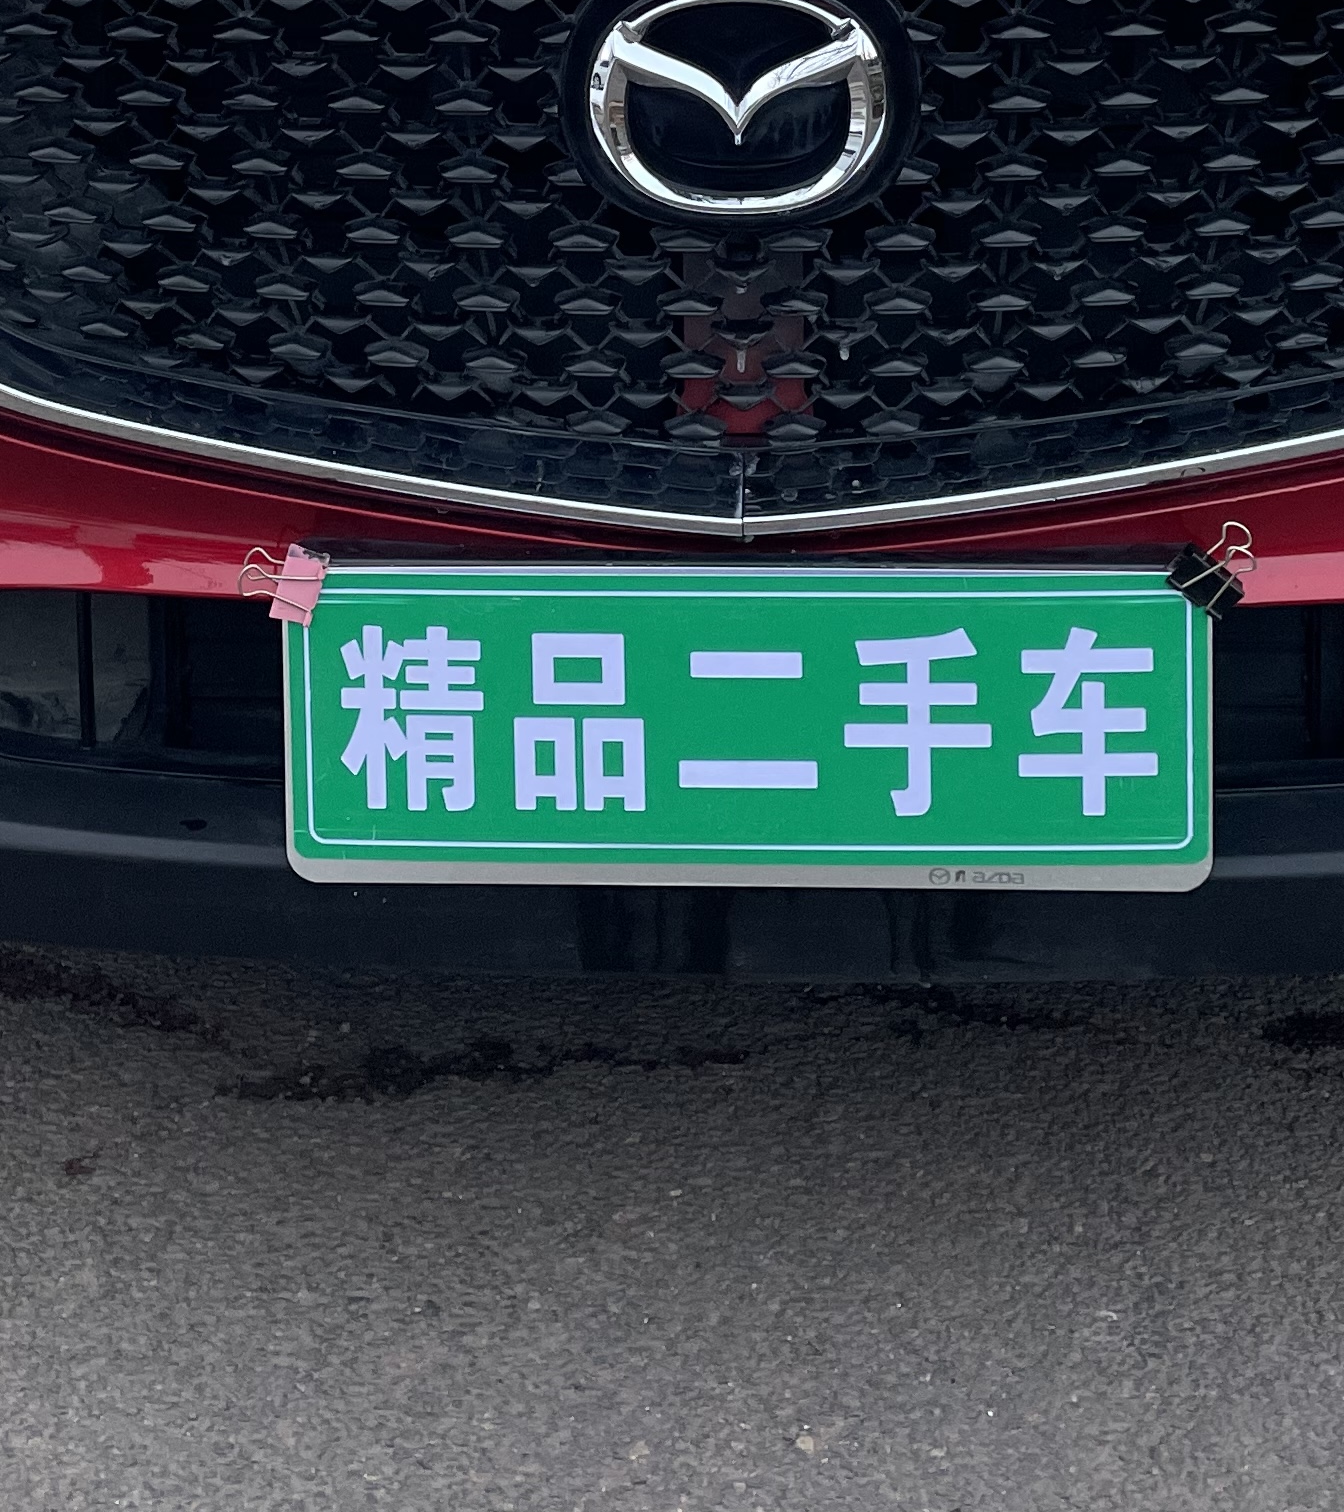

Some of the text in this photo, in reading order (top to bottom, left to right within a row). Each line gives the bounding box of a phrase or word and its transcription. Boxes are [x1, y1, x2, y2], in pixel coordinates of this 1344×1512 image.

[340, 625, 1159, 818] 精品二手车
